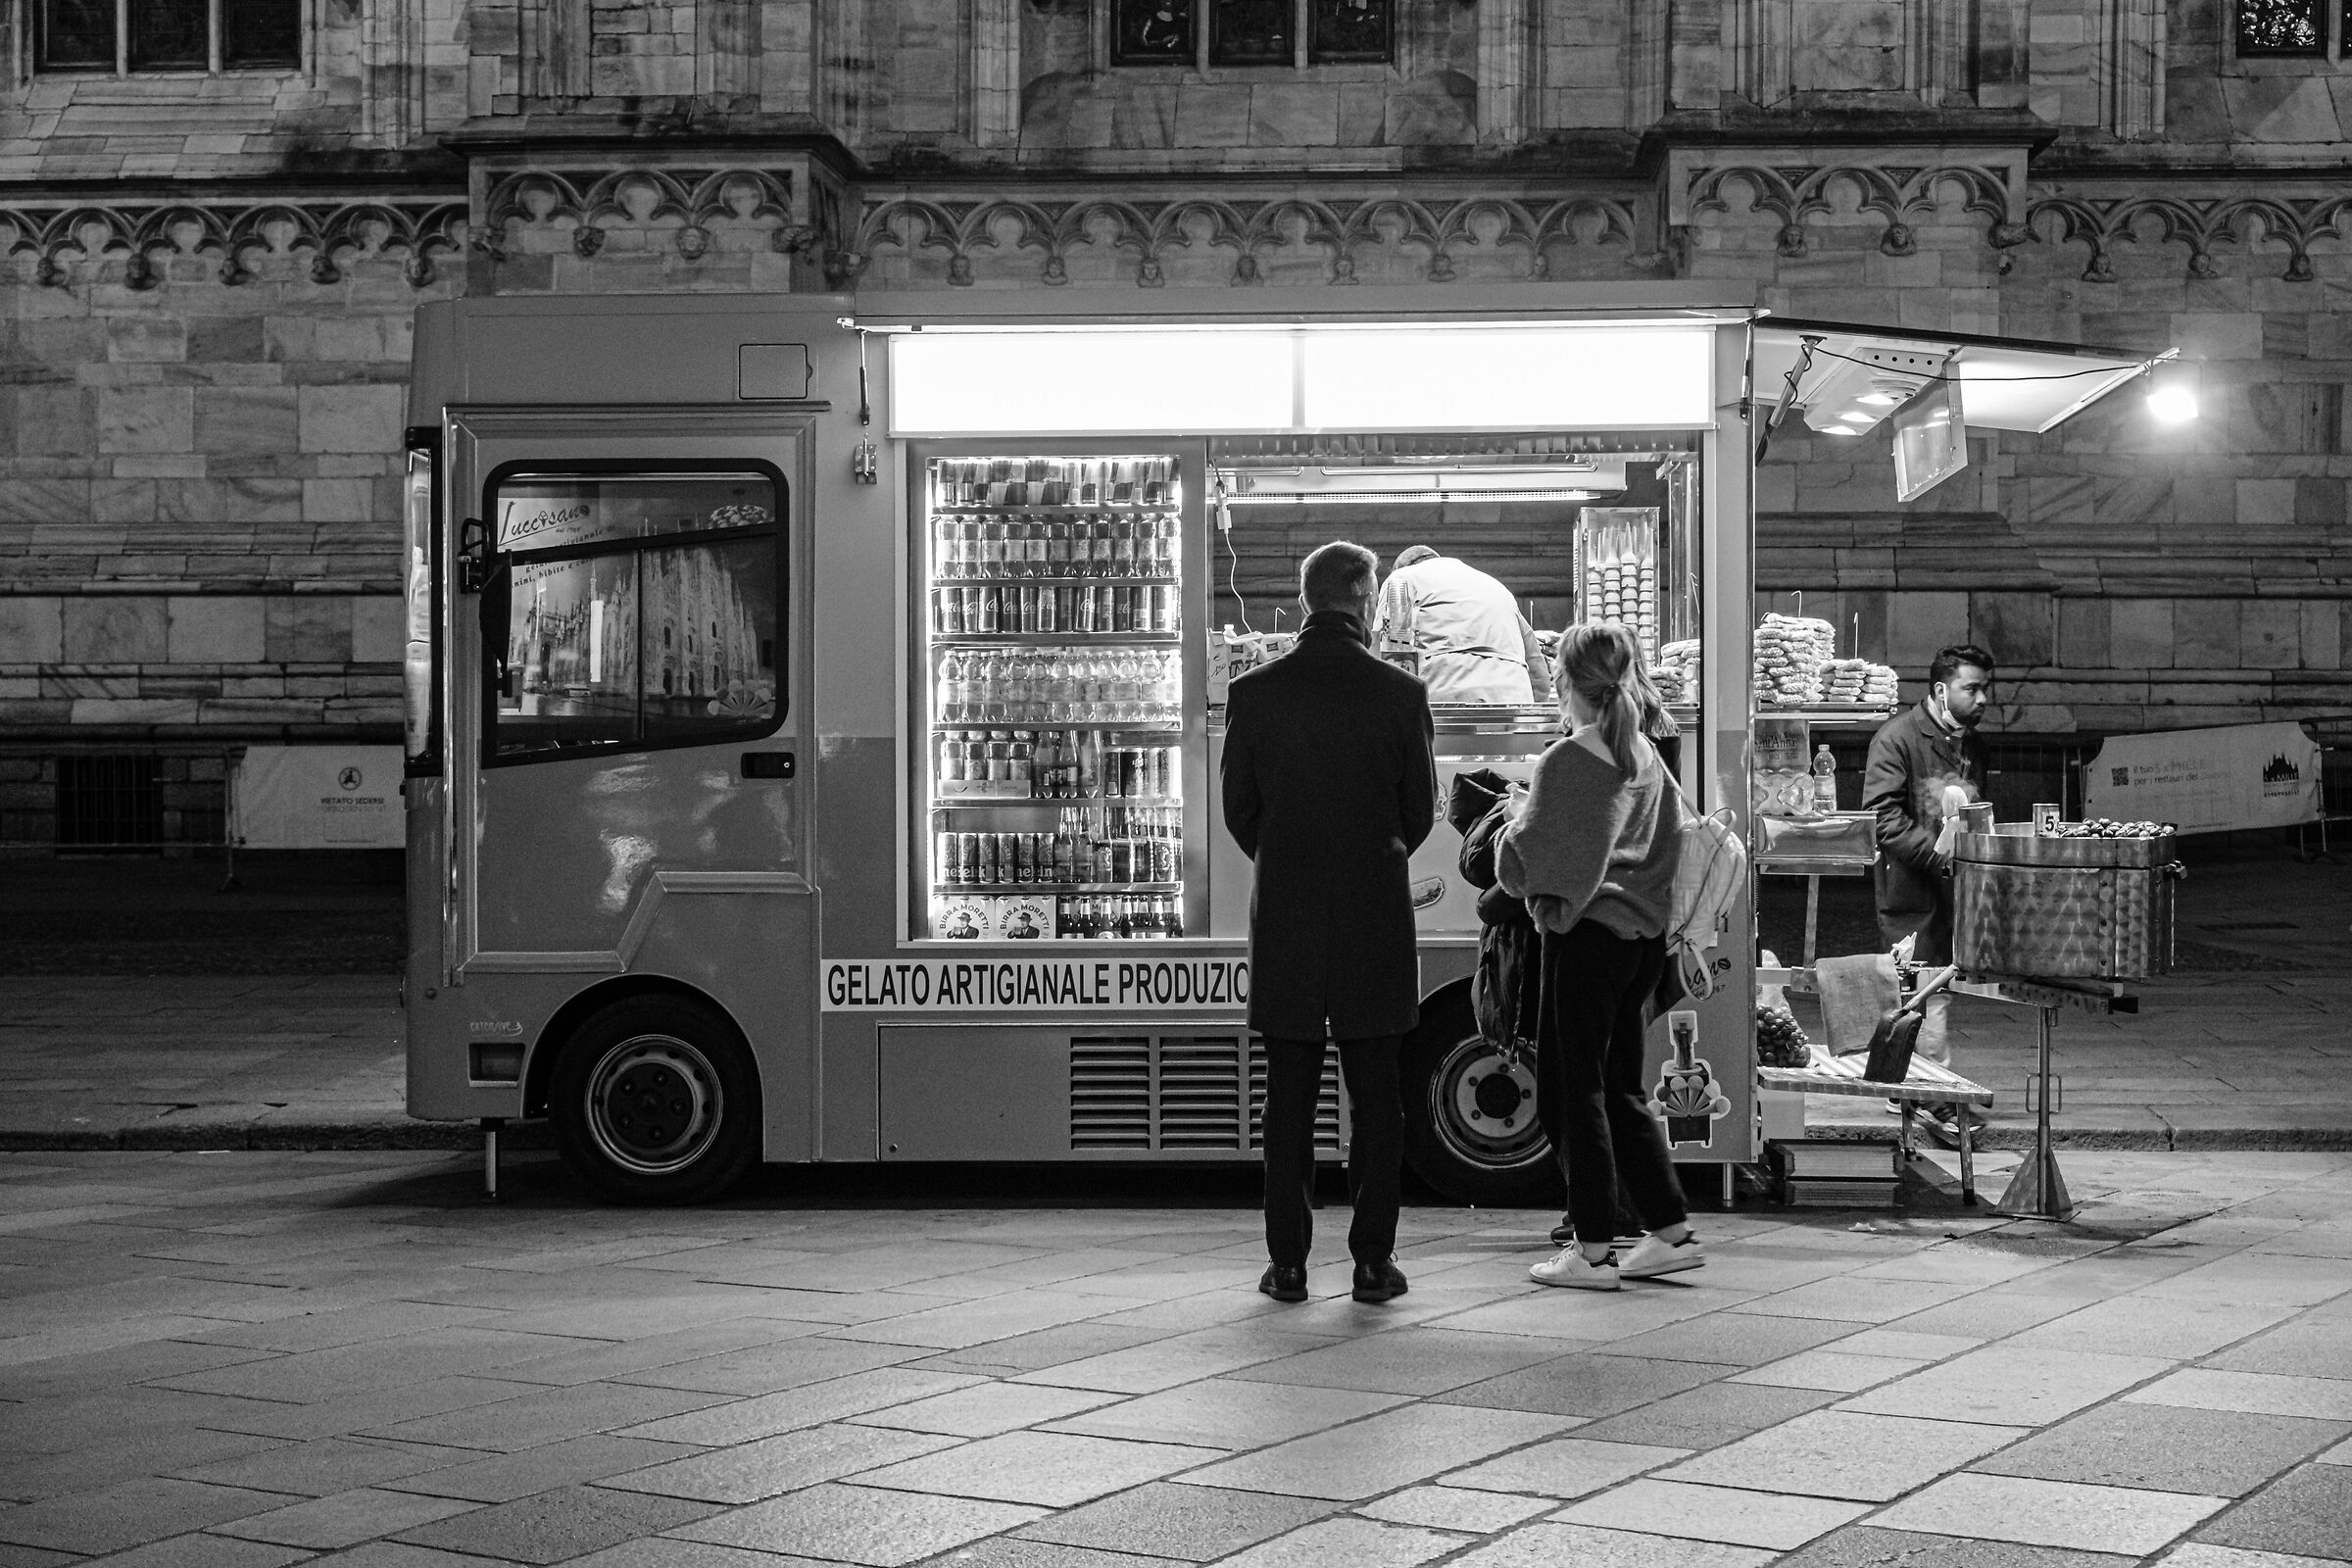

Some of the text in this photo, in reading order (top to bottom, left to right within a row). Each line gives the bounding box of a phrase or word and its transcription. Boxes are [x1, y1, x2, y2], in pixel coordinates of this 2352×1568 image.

[2045, 815, 2055, 832] 5
[939, 904, 990, 930] BIRRA MORETTI
[1000, 904, 1051, 930] BIRRA MORETTI
[827, 964, 930, 1006] GELATO
[936, 963, 1110, 1005] ARTIGIANALE
